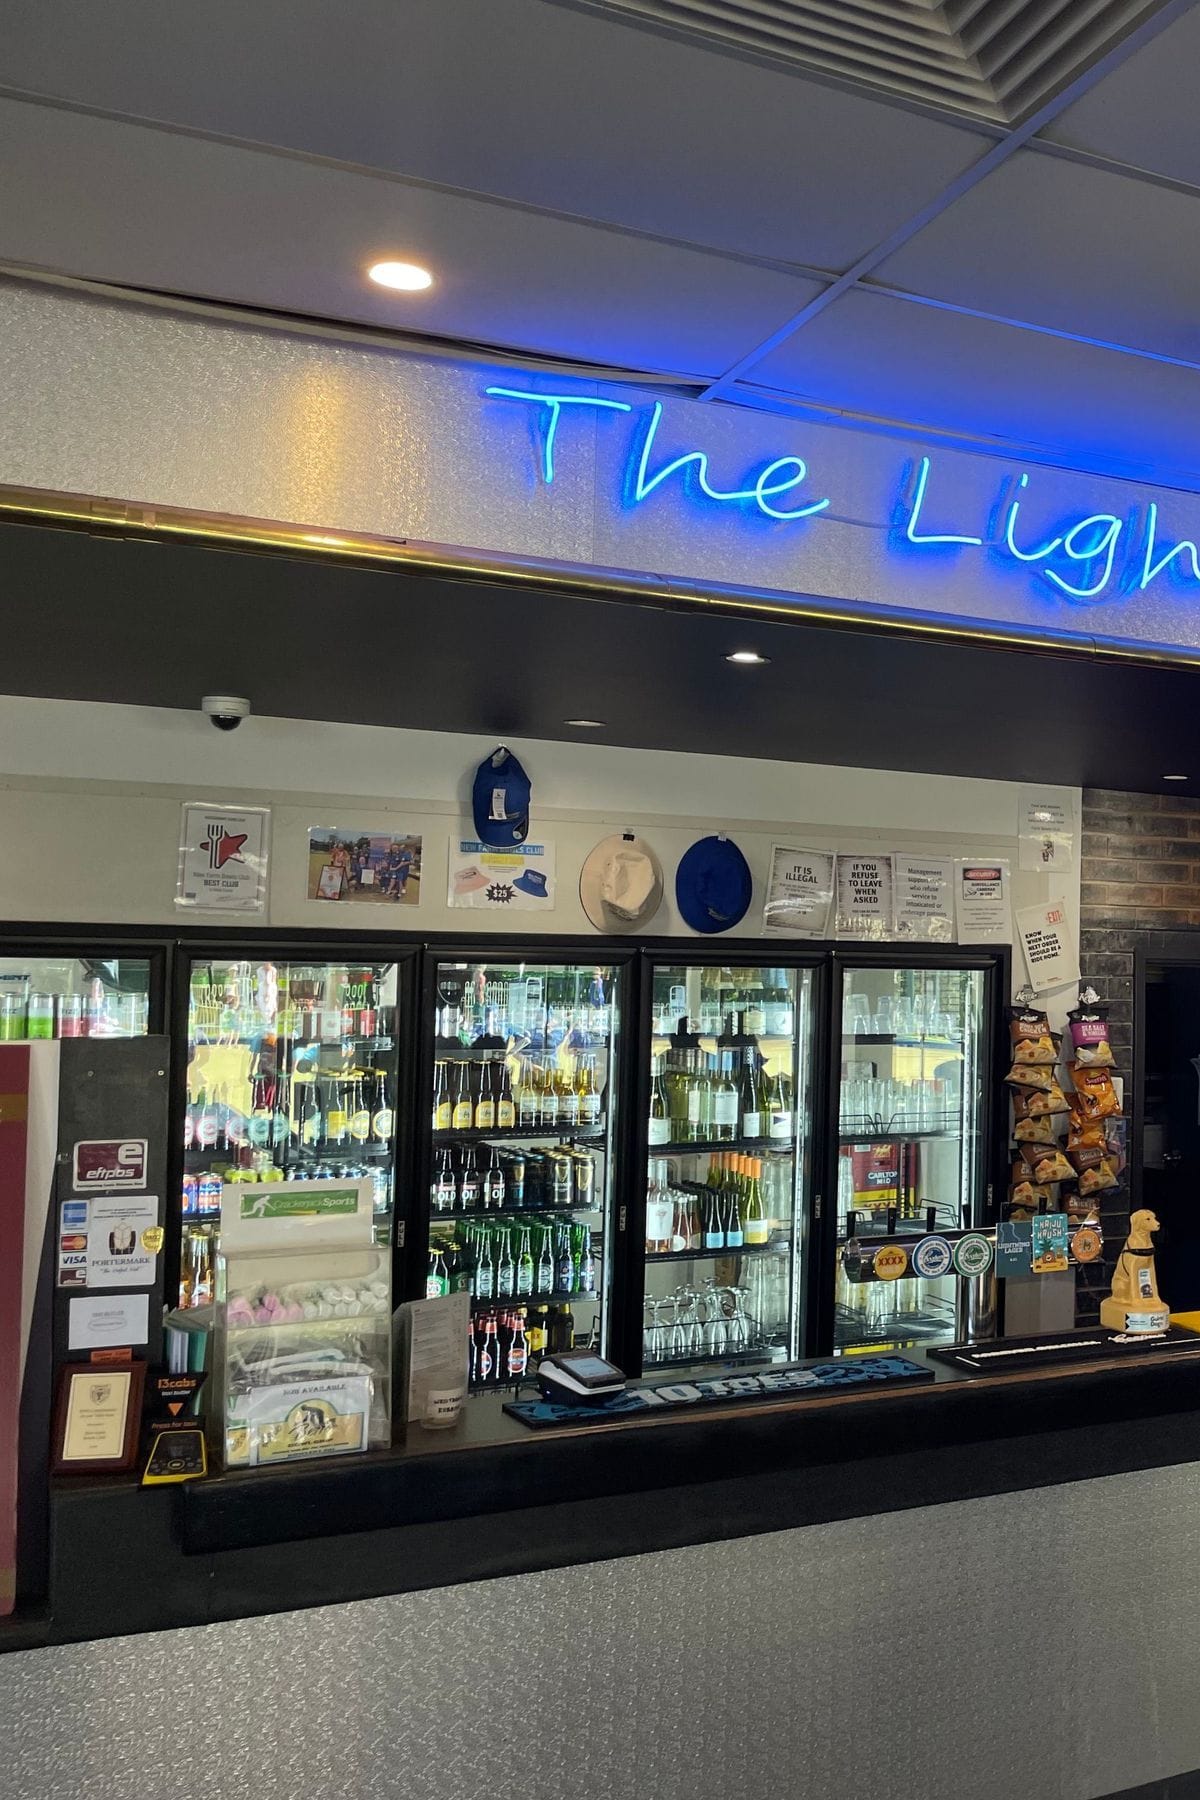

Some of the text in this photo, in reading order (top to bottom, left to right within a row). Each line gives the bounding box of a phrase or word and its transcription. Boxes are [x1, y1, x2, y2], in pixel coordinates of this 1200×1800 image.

[485, 386, 831, 520] The
[907, 867, 942, 876] Management
[785, 872, 818, 884] ILLEGAL
[860, 880, 882, 888] LEAVE
[853, 896, 878, 904] ASKED
[1025, 930, 1042, 939] KNOW
[1026, 933, 1057, 945] WHEN YOUR
[1042, 939, 1059, 948] ORDER
[1029, 948, 1050, 958] SHOULD
[86, 1166, 135, 1180] eftpos
[437, 1190, 456, 1201] OLD
[63, 1255, 87, 1265] VISA
[878, 1255, 904, 1266] XXXX
[158, 1378, 197, 1389] 13cabs
